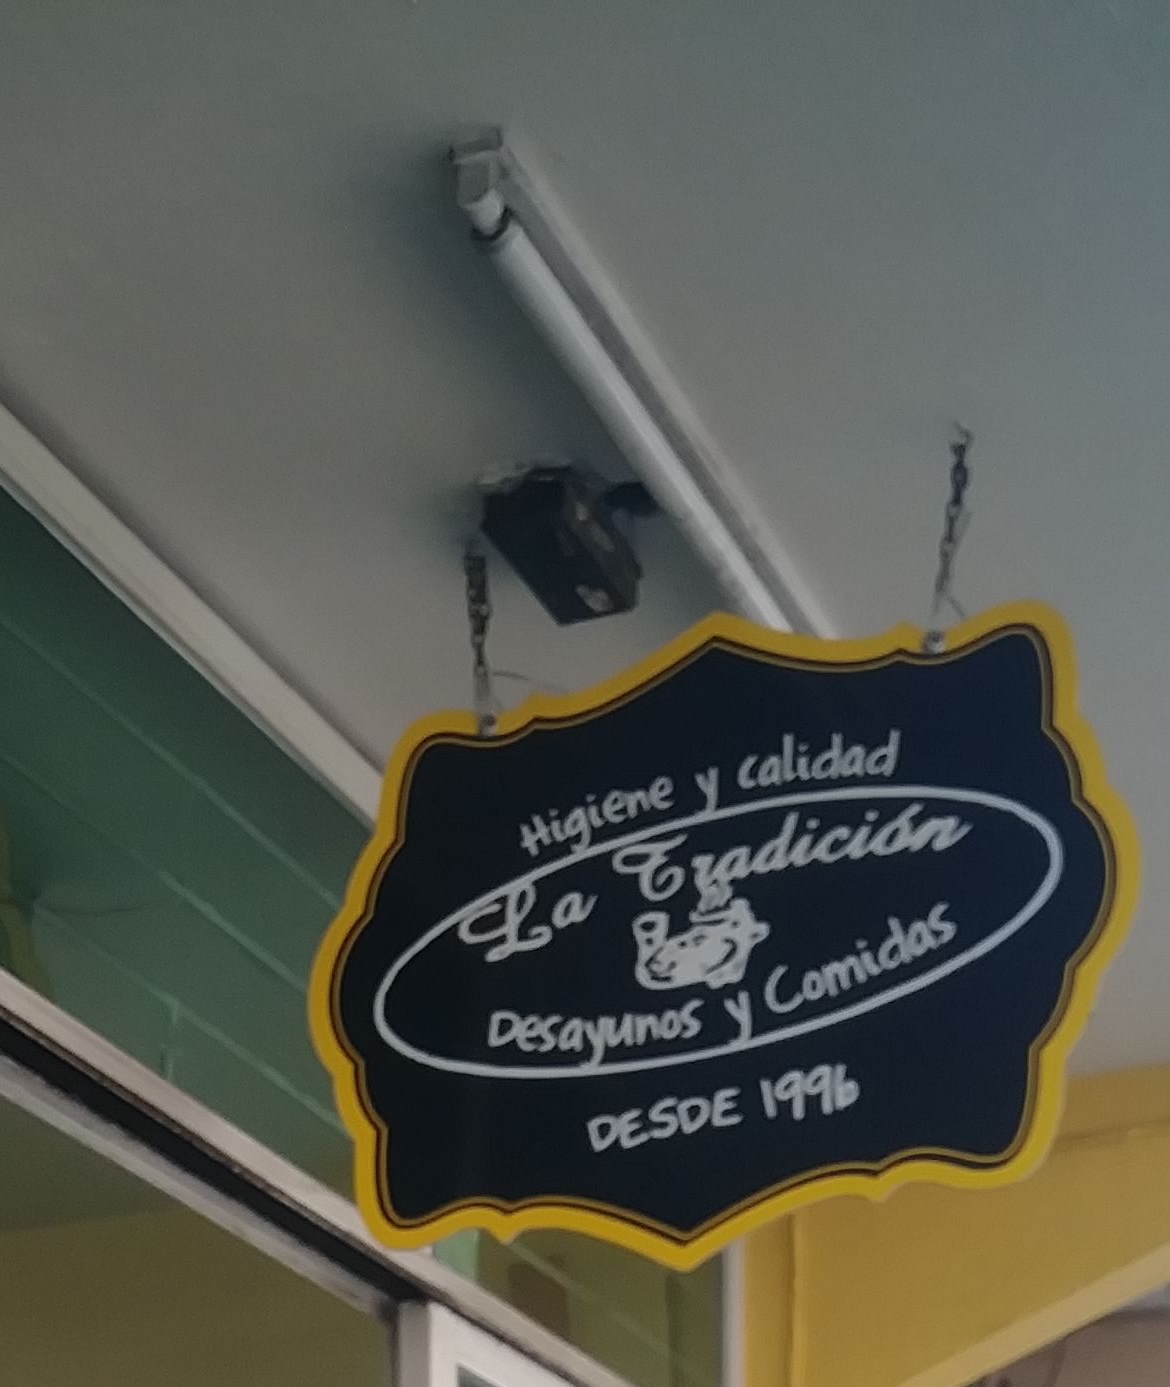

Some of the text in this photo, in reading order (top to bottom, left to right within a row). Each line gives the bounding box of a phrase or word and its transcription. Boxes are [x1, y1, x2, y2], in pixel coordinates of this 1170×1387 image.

[520, 729, 902, 856] Higiene y calidad
[457, 802, 973, 962] La Tradición
[487, 902, 958, 1068] Desayunos y Comidas
[586, 1063, 861, 1152] DESDE 1996
